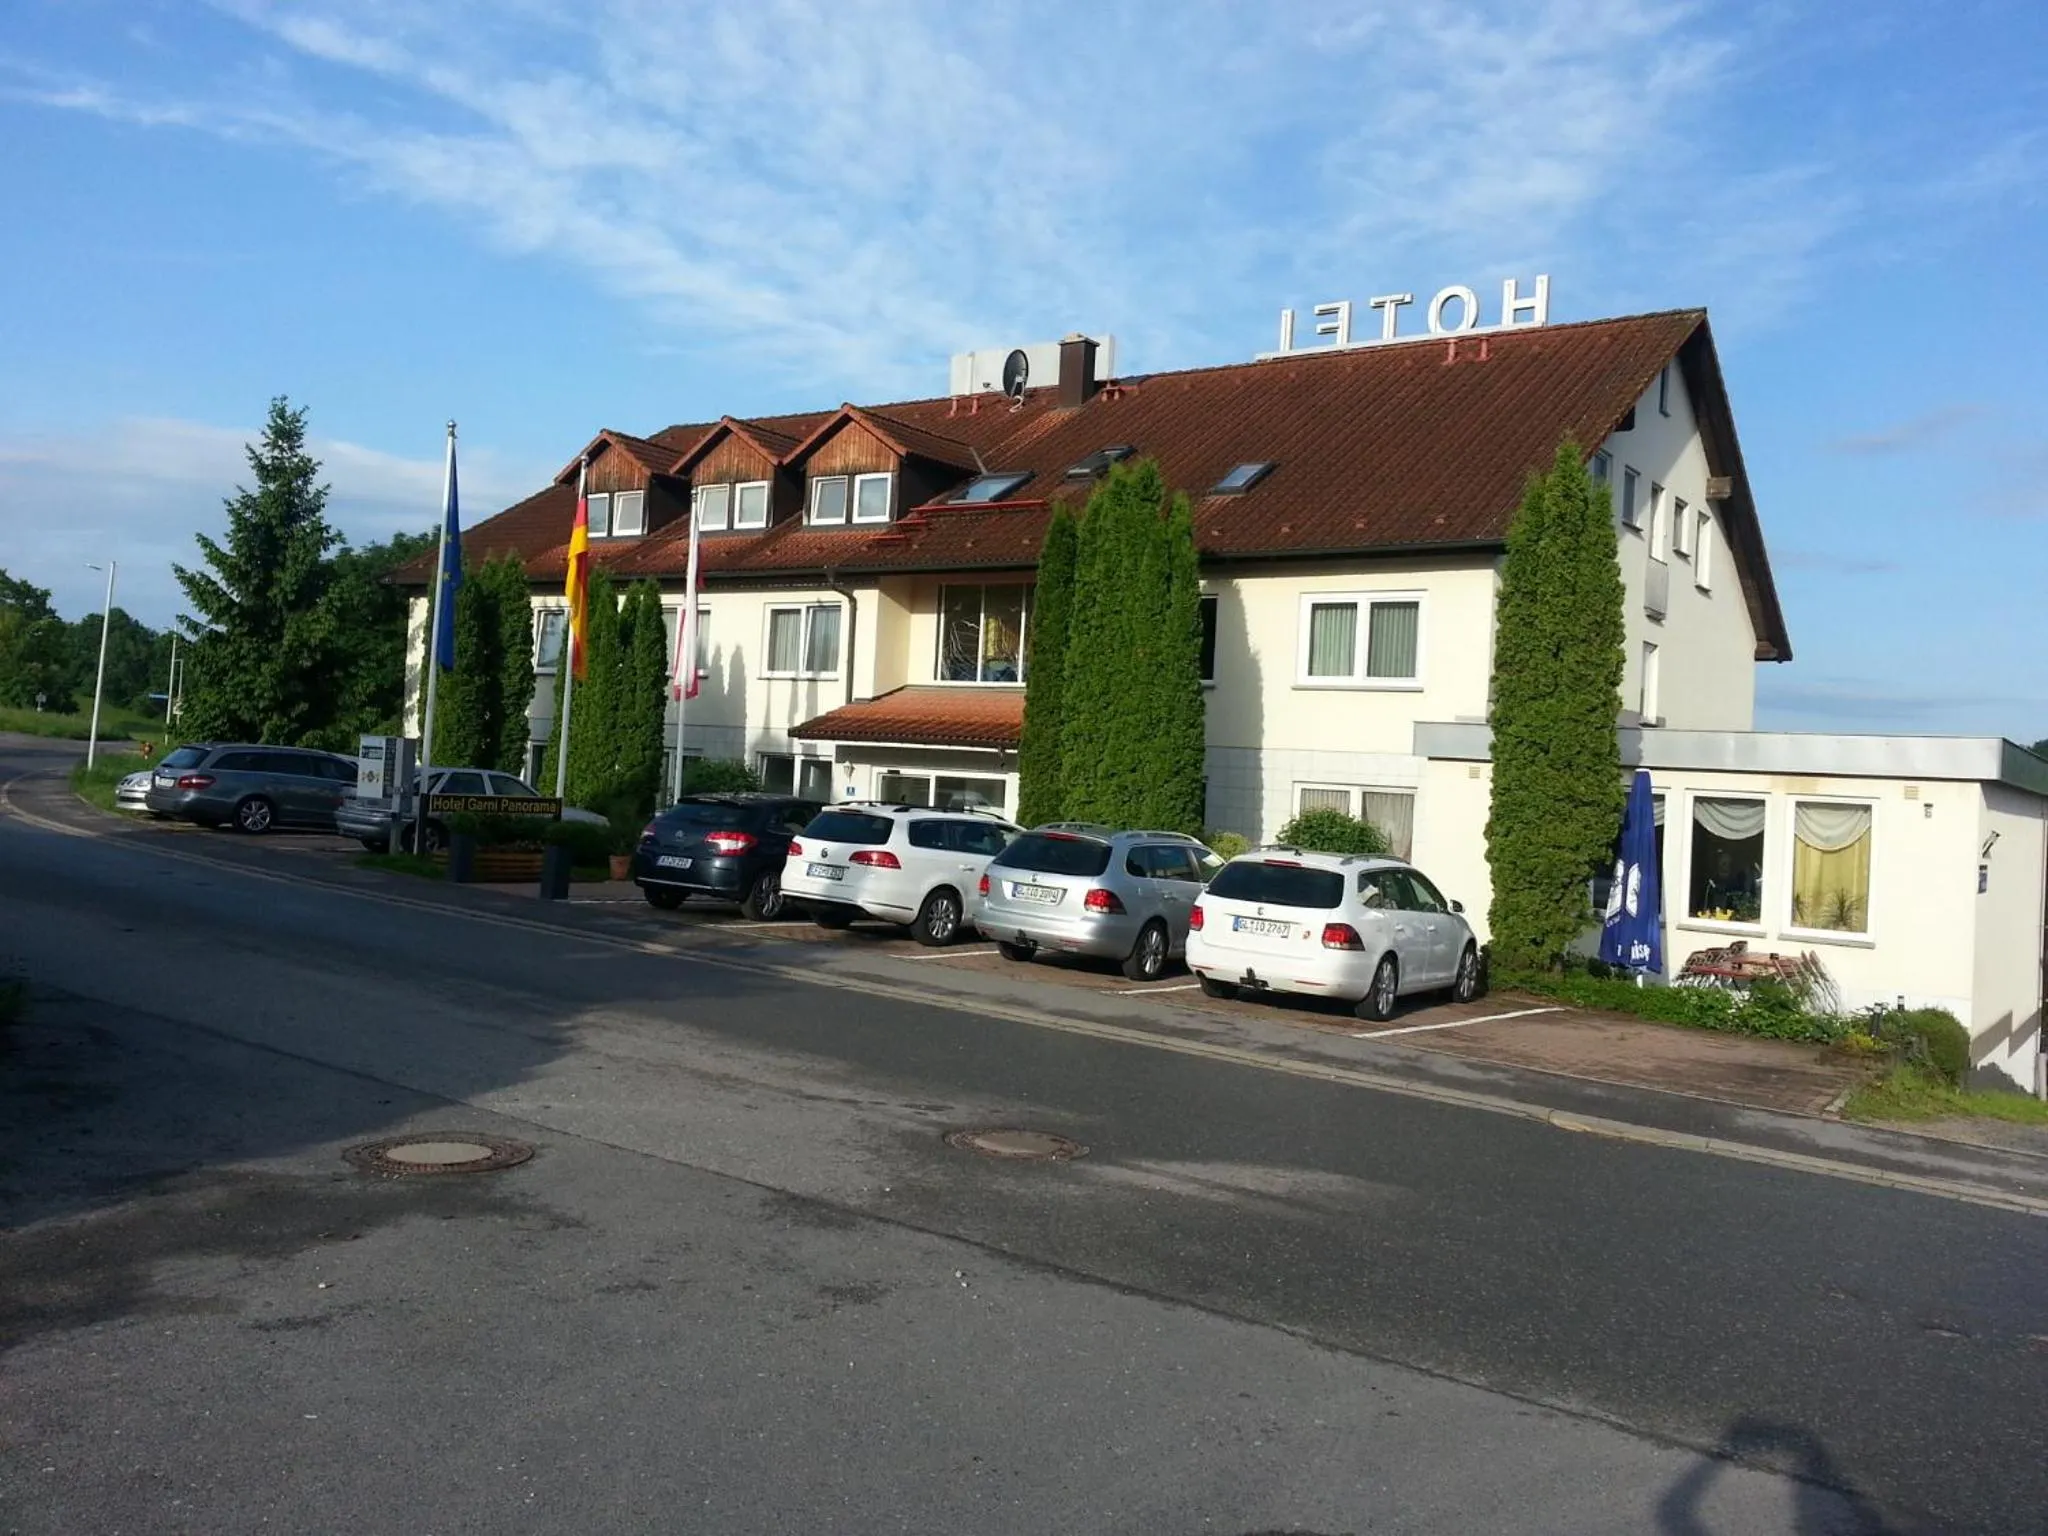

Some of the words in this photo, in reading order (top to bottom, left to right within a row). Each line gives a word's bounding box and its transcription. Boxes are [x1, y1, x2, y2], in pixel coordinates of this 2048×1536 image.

[433, 797, 465, 811] Hotel
[468, 799, 498, 812] Garni
[501, 799, 557, 813] Panorama
